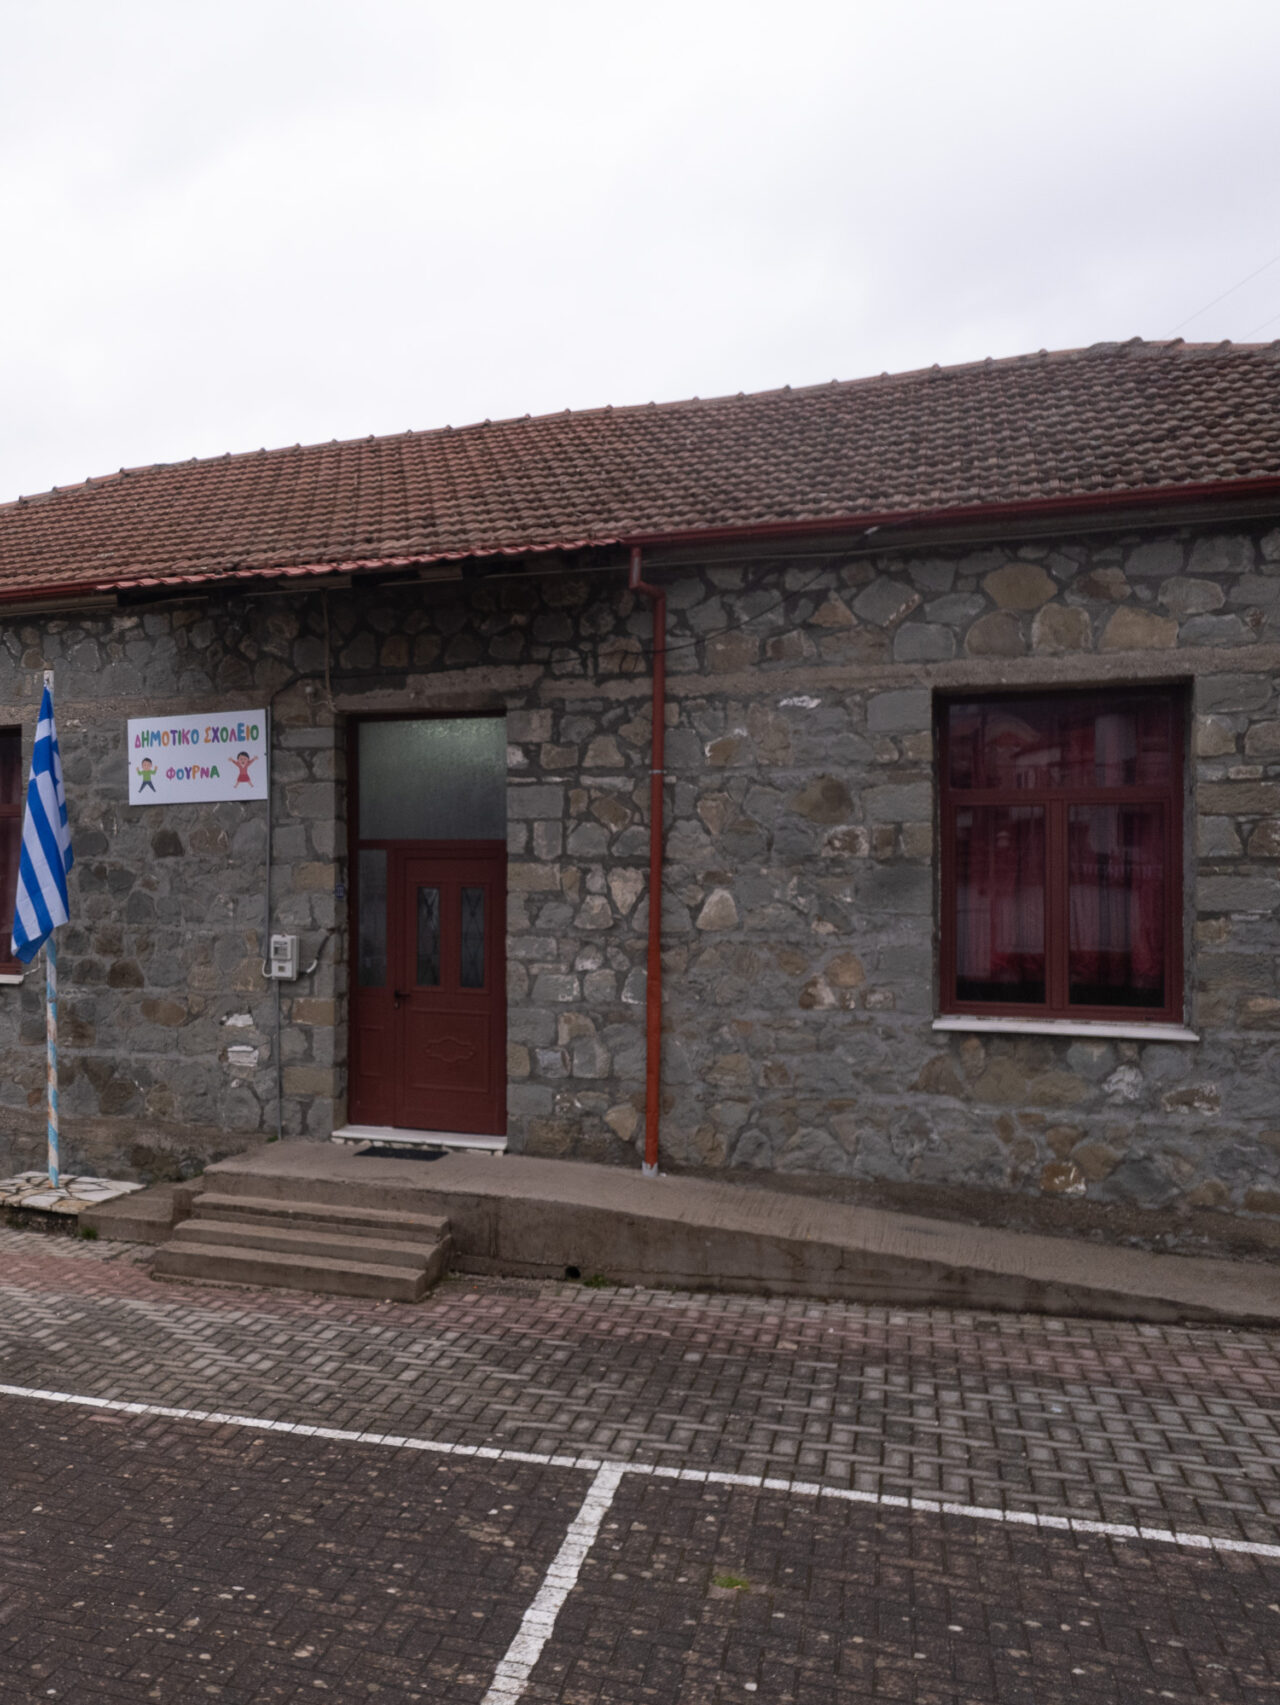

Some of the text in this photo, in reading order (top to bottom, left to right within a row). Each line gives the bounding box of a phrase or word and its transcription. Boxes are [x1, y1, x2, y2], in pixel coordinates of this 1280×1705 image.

[134, 722, 259, 749] ΔΗΜΟΤΙΚΟ ΣΧΟΛΕΙΟ
[166, 765, 220, 780] ΦΟΥΡΝΑ
